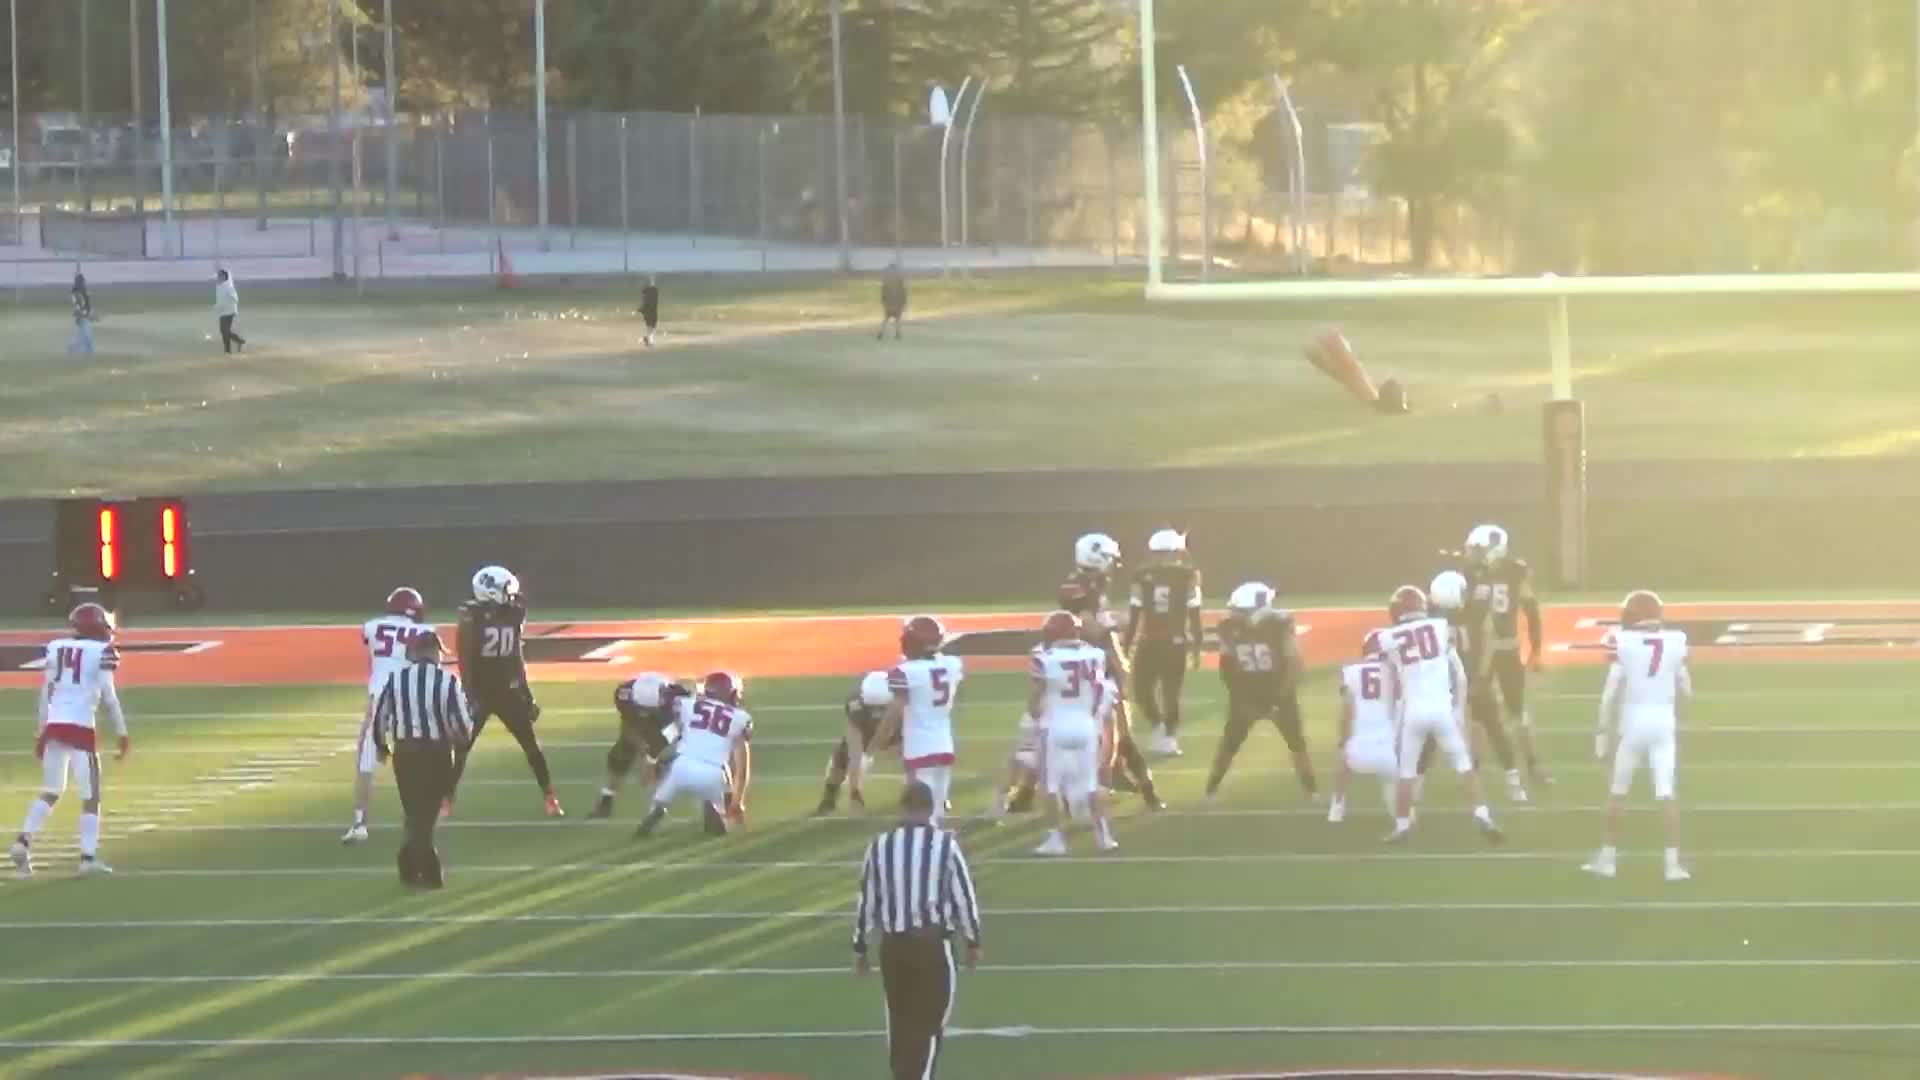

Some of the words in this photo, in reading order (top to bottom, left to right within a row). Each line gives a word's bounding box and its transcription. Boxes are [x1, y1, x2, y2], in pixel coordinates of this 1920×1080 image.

[98, 507, 182, 579] 11
[374, 624, 421, 657] 54
[480, 626, 514, 657] 20
[1392, 624, 1440, 664] 20
[1643, 638, 1664, 678] 7
[55, 647, 83, 685] 14
[1060, 658, 1105, 700] 34
[1361, 667, 1382, 700] 6
[929, 667, 950, 707] 5
[688, 700, 734, 738] 56
